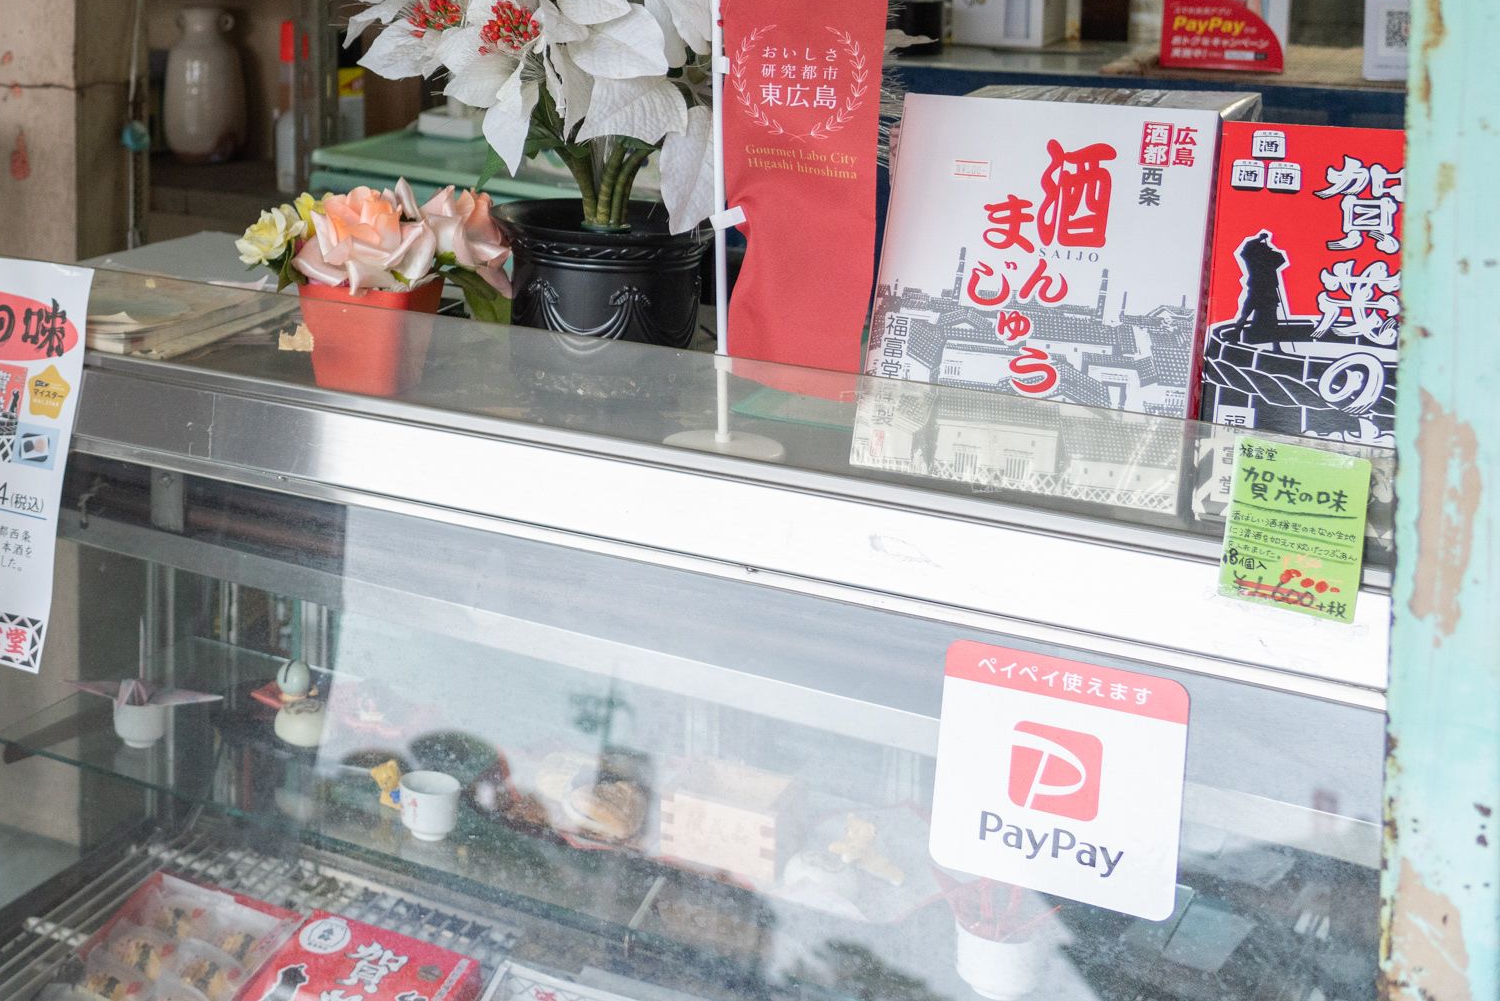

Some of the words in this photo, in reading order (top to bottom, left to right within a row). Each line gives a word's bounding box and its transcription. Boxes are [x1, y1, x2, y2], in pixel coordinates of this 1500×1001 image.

[1173, 14, 1246, 37] PayPay
[762, 46, 838, 62] おいしさ
[761, 63, 839, 81] 研究都市
[759, 83, 837, 110] 東広島
[745, 143, 796, 159] Gourmet
[800, 149, 827, 163] Labo
[830, 152, 858, 168] City
[1172, 127, 1198, 167] 広島
[1258, 140, 1279, 153] 酒
[748, 157, 793, 173] Higashi
[1238, 169, 1258, 183] 酒
[1273, 172, 1294, 185] 酒
[1038, 247, 1100, 263] SAIJO
[1239, 443, 1278, 462] 福富堂
[1242, 466, 1349, 512] 賀茂の味
[978, 657, 1153, 705] ペイペイ使えます
[978, 810, 1125, 878] PayPay
